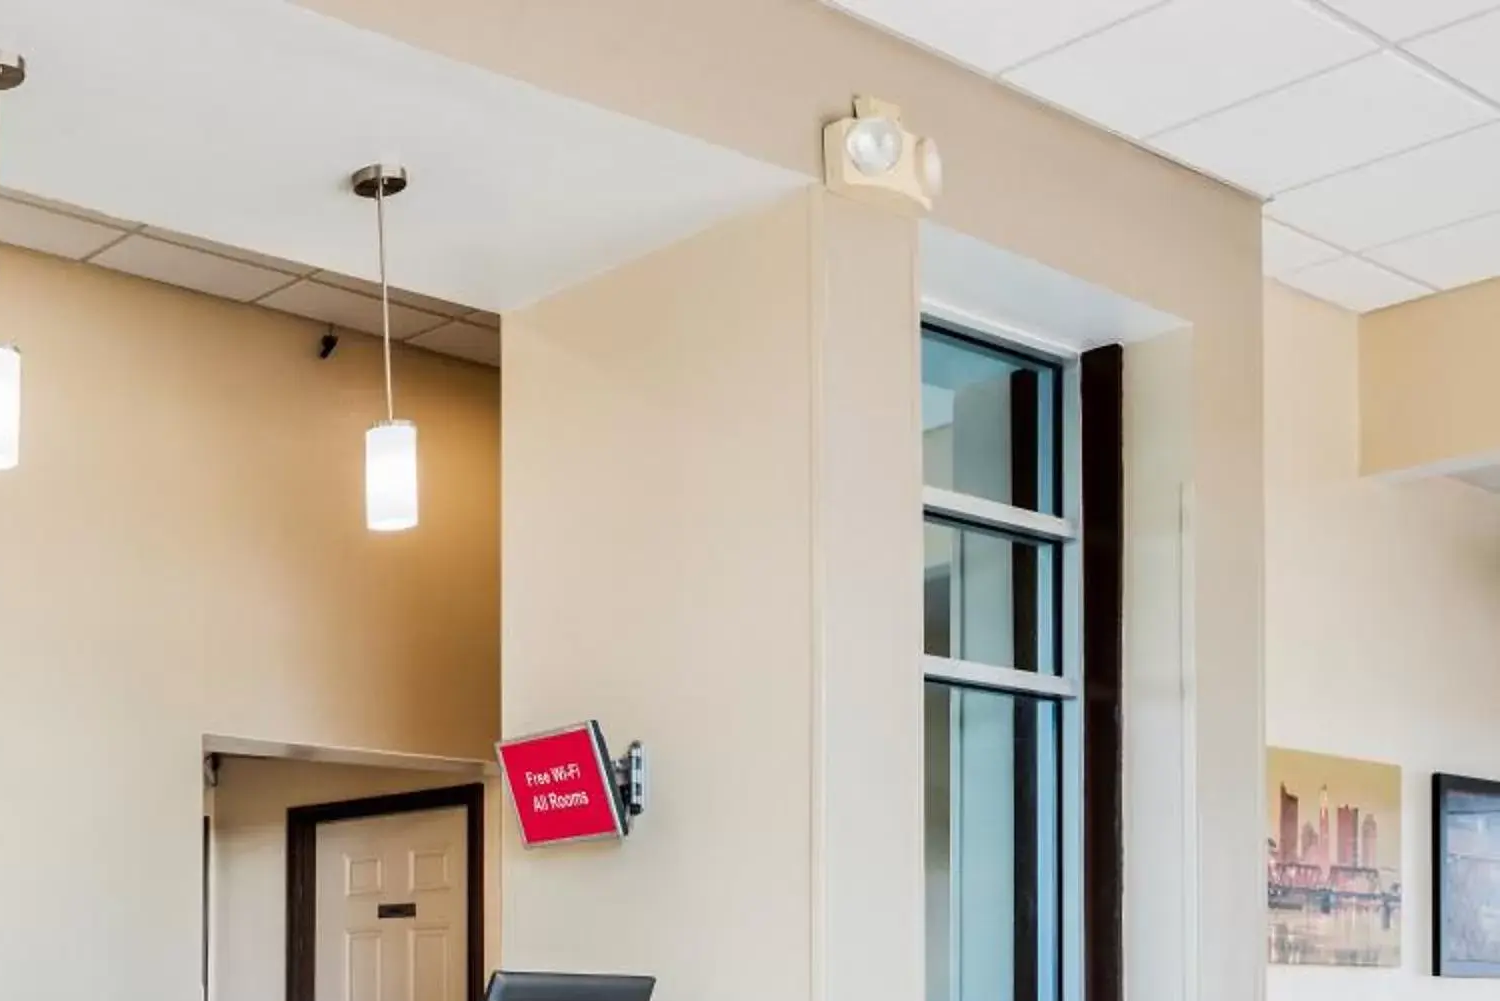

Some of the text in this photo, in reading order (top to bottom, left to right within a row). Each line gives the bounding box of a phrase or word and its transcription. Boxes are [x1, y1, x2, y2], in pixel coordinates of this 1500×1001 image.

[525, 771, 550, 787] Free
[533, 791, 589, 812] All Rooms
